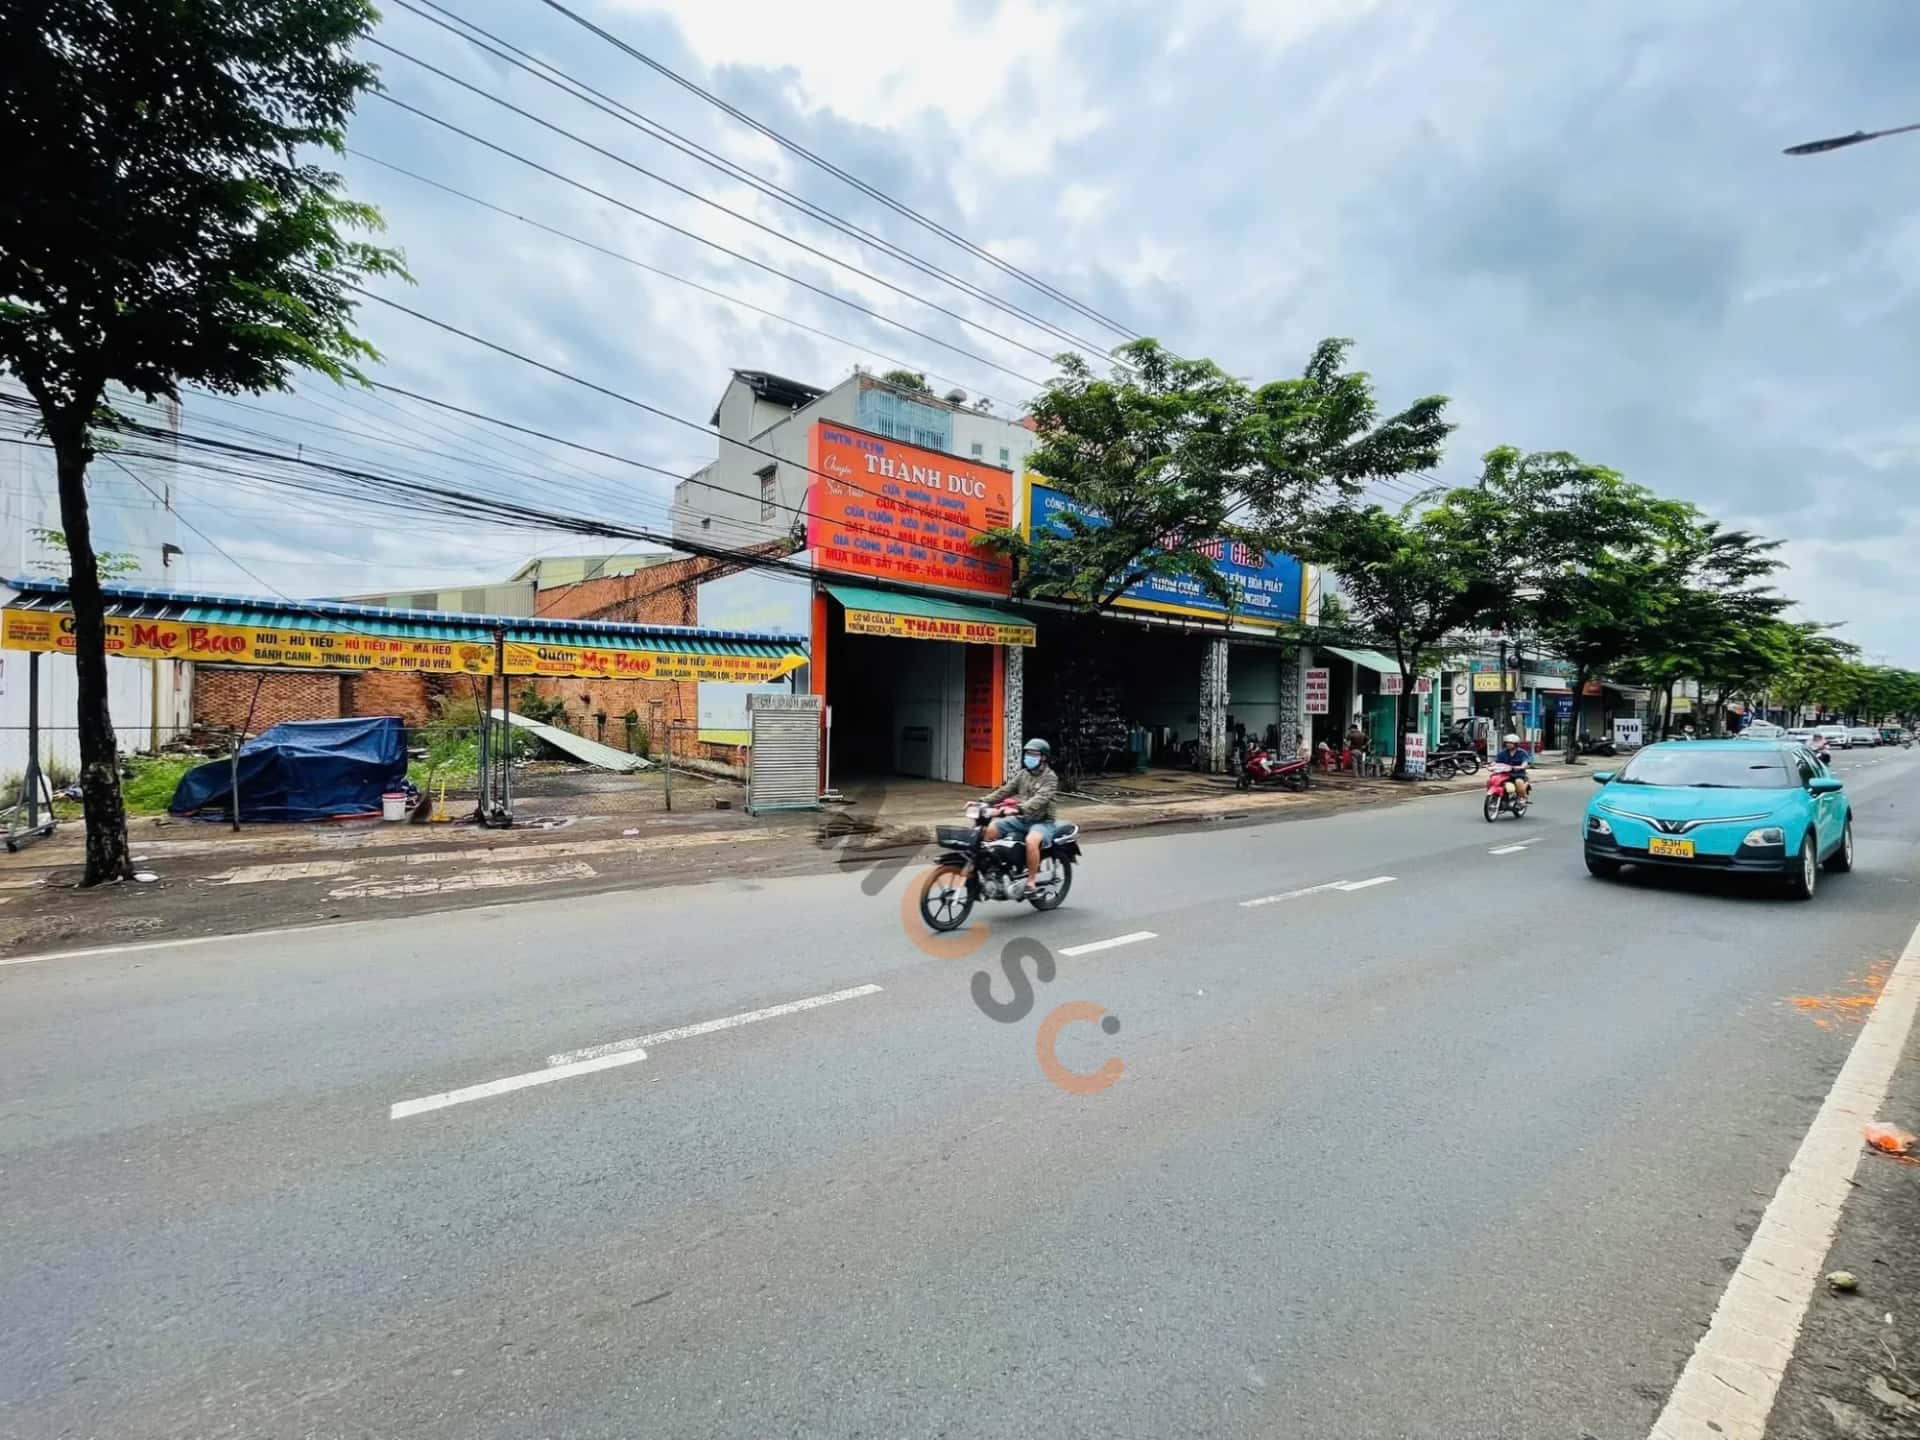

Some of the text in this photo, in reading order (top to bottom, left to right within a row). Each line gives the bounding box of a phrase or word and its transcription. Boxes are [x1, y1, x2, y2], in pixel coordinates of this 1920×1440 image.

[864, 453, 941, 489] THÀNH
[1044, 497, 1065, 512] CÔNG
[1263, 577, 1283, 593] PHÁT
[256, 633, 277, 644] NUI
[289, 632, 305, 646] HỦ
[432, 645, 451, 656] HEO
